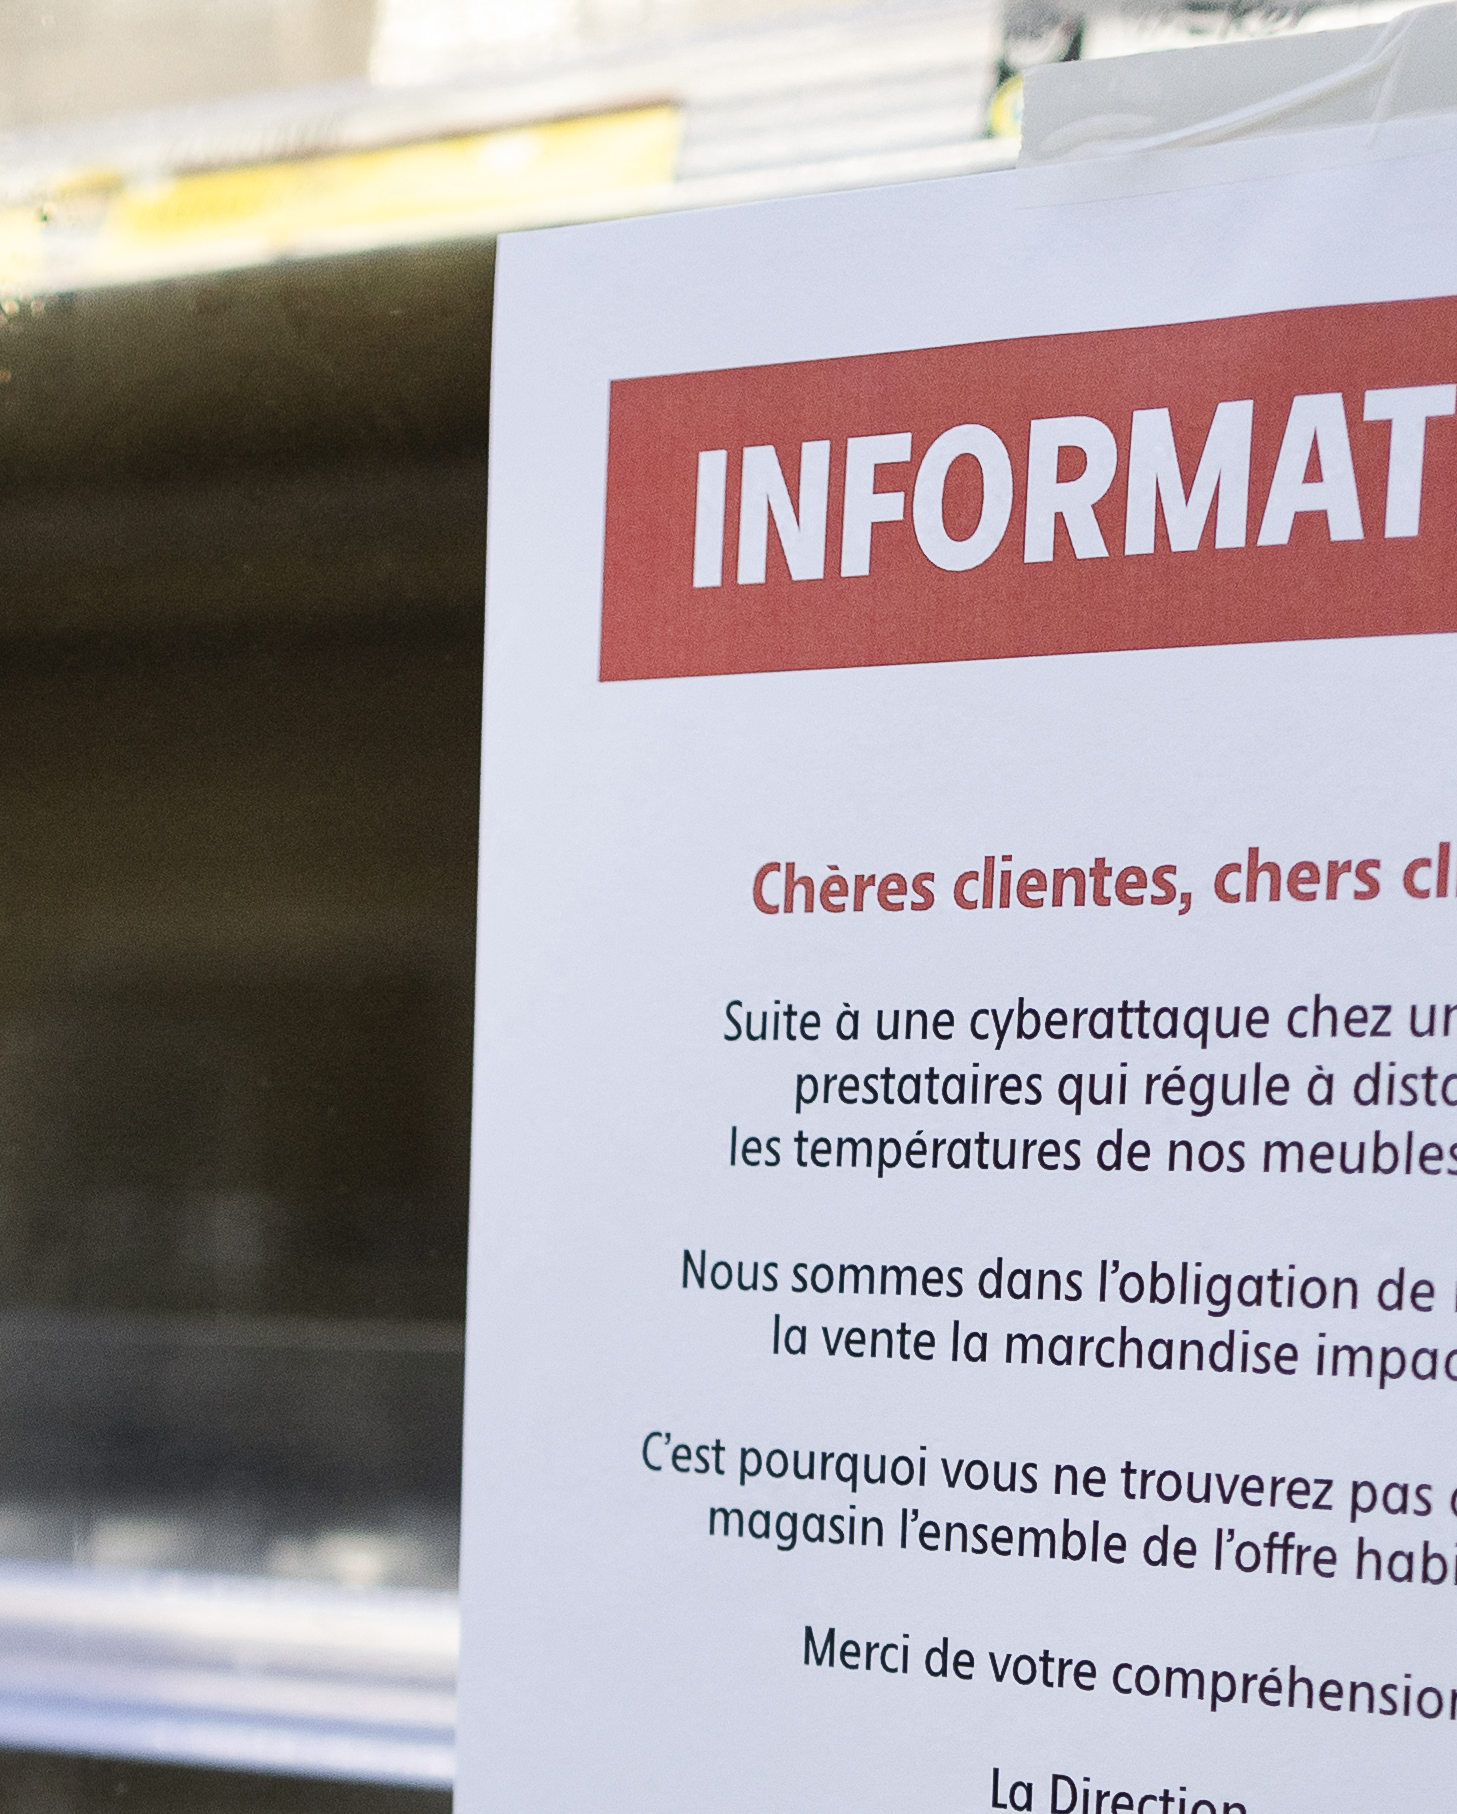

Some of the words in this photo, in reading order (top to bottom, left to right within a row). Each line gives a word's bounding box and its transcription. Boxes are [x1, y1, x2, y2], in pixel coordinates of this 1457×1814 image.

[752, 861, 935, 915] Chères
[953, 854, 1192, 916] clientes,
[1214, 846, 1381, 904] chers
[724, 999, 821, 1042] Suite
[836, 1002, 859, 1041] à
[876, 1009, 955, 1041] une
[970, 996, 1270, 1051] cyberattaque
[1287, 993, 1392, 1039] chez
[795, 1062, 1042, 1114] prestataires
[1058, 1062, 1128, 1116] qui
[1145, 1062, 1290, 1117] régule
[1307, 1065, 1334, 1106] à
[730, 1125, 781, 1167] les
[793, 1130, 1081, 1179] températures
[1096, 1128, 1151, 1172] de
[1168, 1140, 1245, 1173] nos
[682, 1249, 778, 1292] Nous
[791, 1262, 963, 1298] sommes
[978, 1256, 1082, 1302] dans
[1377, 1267, 1435, 1313] de
[773, 1313, 807, 1355] la
[822, 1322, 936, 1361] vente
[952, 1319, 988, 1363] la
[1005, 1325, 1299, 1375] marchandise
[740, 1445, 927, 1493] pourquoi
[941, 1458, 1038, 1494] vous
[1054, 1464, 1106, 1498] ne
[1120, 1460, 1334, 1511] trouverez
[1350, 1480, 1432, 1523] pas
[709, 1504, 883, 1552] magasin
[1143, 1524, 1197, 1569] de
[804, 1625, 910, 1674] Merci
[925, 1636, 975, 1680] de
[988, 1649, 1097, 1691] votre
[992, 1767, 1033, 1812] La
